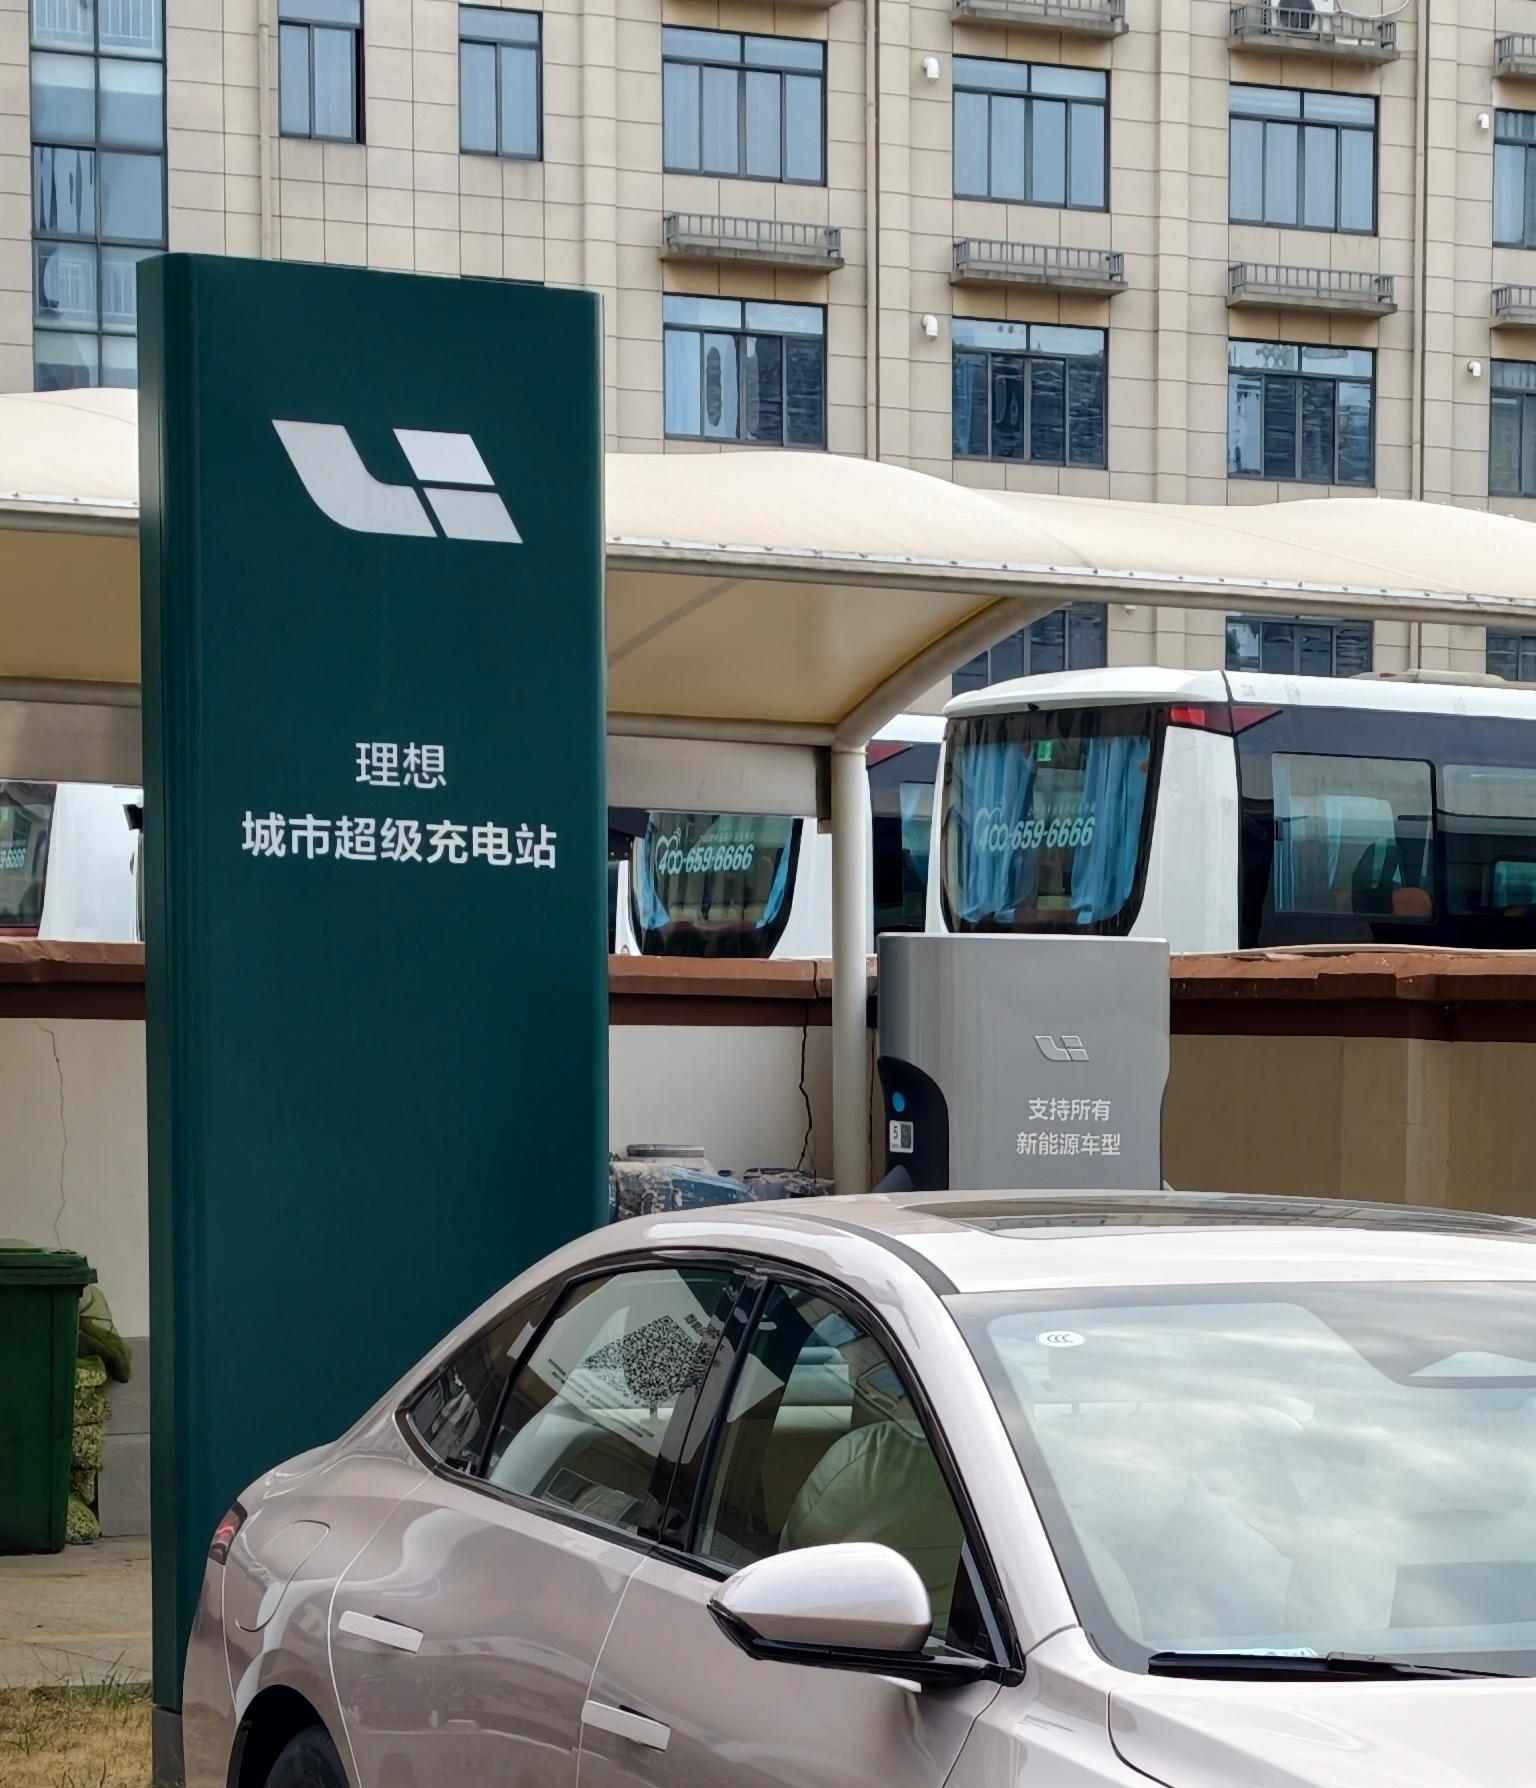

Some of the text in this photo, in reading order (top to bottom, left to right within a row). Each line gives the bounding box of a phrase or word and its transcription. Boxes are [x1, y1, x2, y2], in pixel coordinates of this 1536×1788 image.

[355, 742, 447, 789] 理想
[241, 811, 557, 869] 城市超级充电站
[658, 843, 755, 875] 400-659-6666
[1028, 1097, 1111, 1121] 支持所有
[1016, 1131, 1121, 1156] 新能源车型
